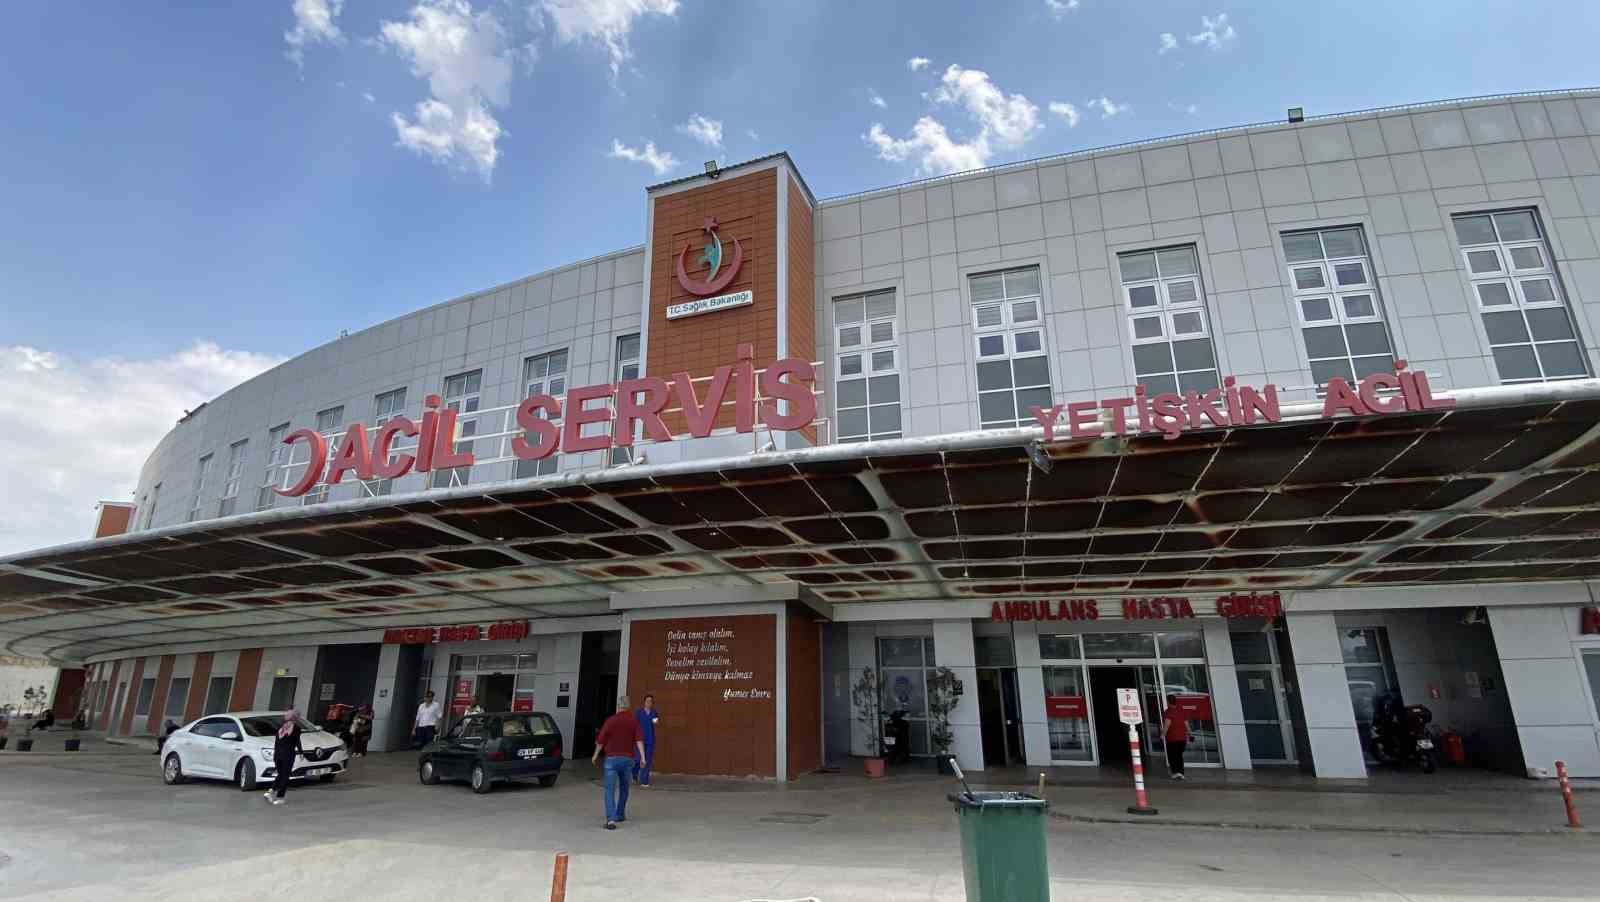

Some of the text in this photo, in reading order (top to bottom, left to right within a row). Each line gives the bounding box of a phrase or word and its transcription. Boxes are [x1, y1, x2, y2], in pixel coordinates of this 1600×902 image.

[326, 343, 817, 485] ACİL SERVİS
[1030, 360, 1456, 440] YETİŞKİN ACİL
[991, 600, 1099, 622] AMBULANS
[1121, 597, 1195, 621] HASTA
